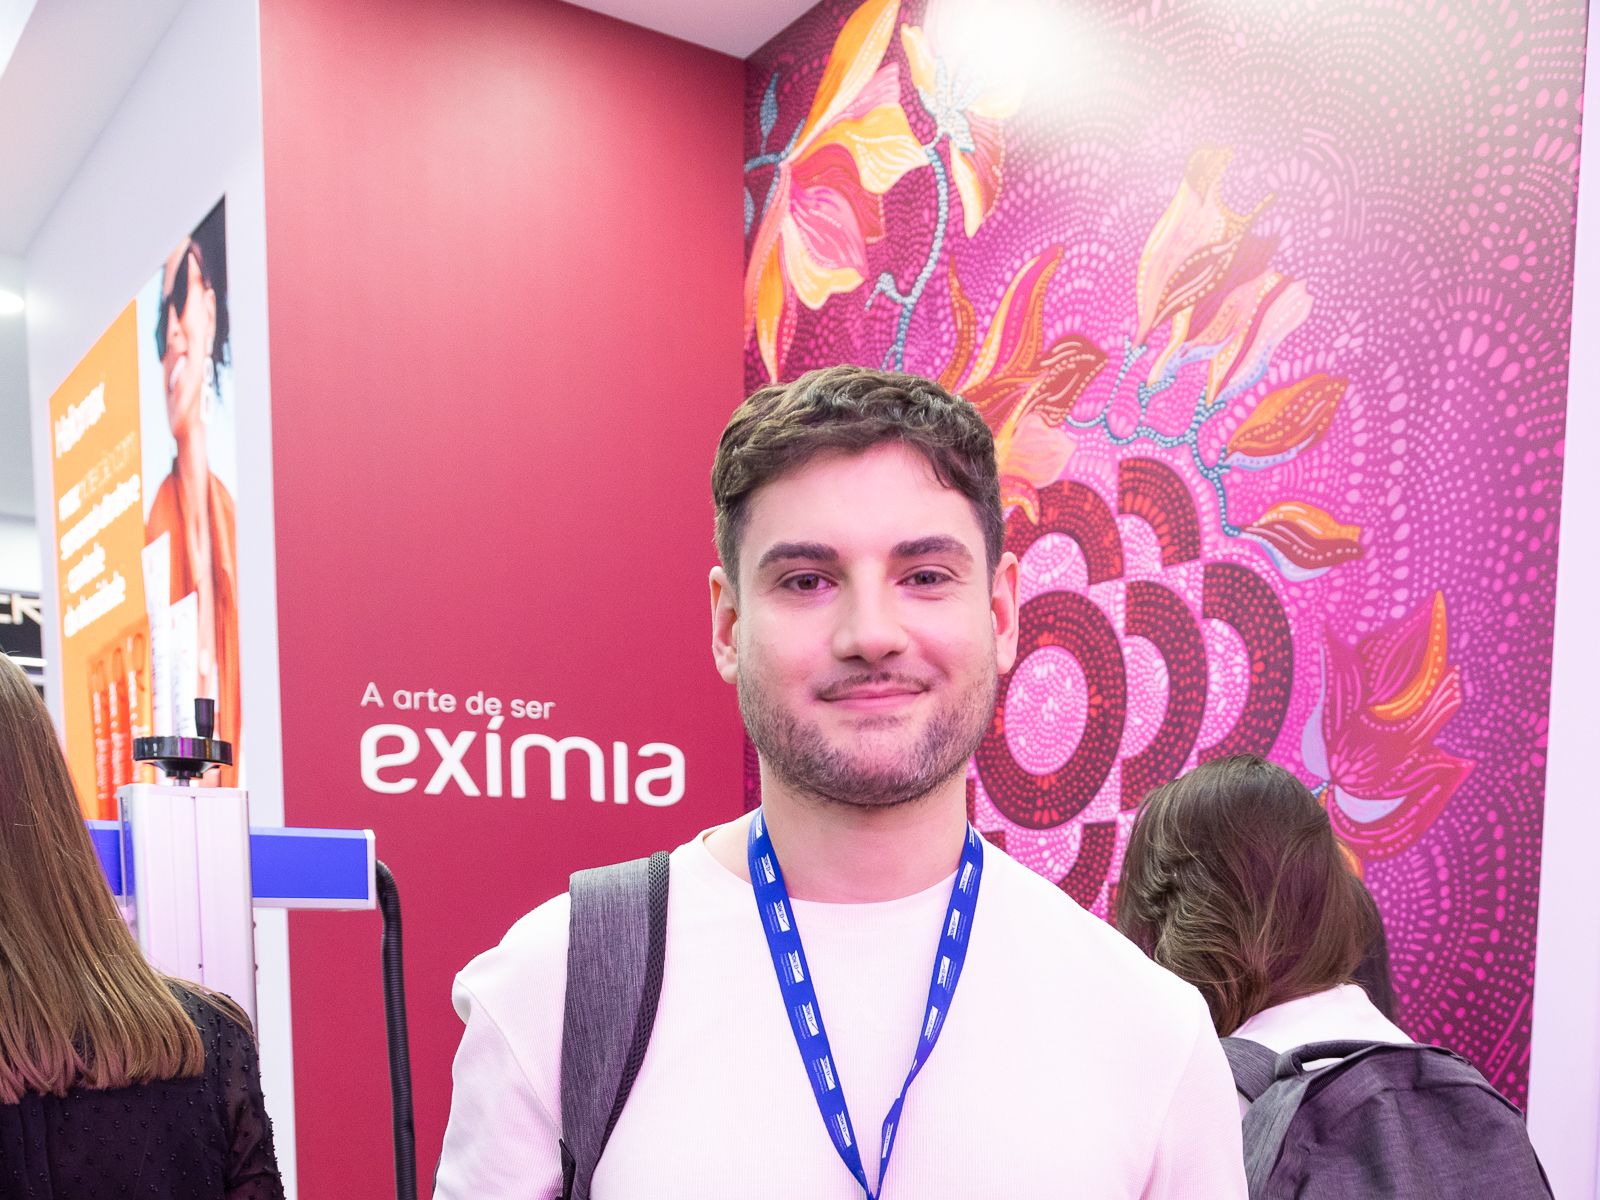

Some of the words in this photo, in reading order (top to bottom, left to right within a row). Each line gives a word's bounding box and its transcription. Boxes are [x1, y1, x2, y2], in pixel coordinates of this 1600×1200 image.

[360, 681, 385, 708] A
[392, 687, 457, 713] arte
[465, 690, 502, 717] de
[510, 698, 557, 721] ser
